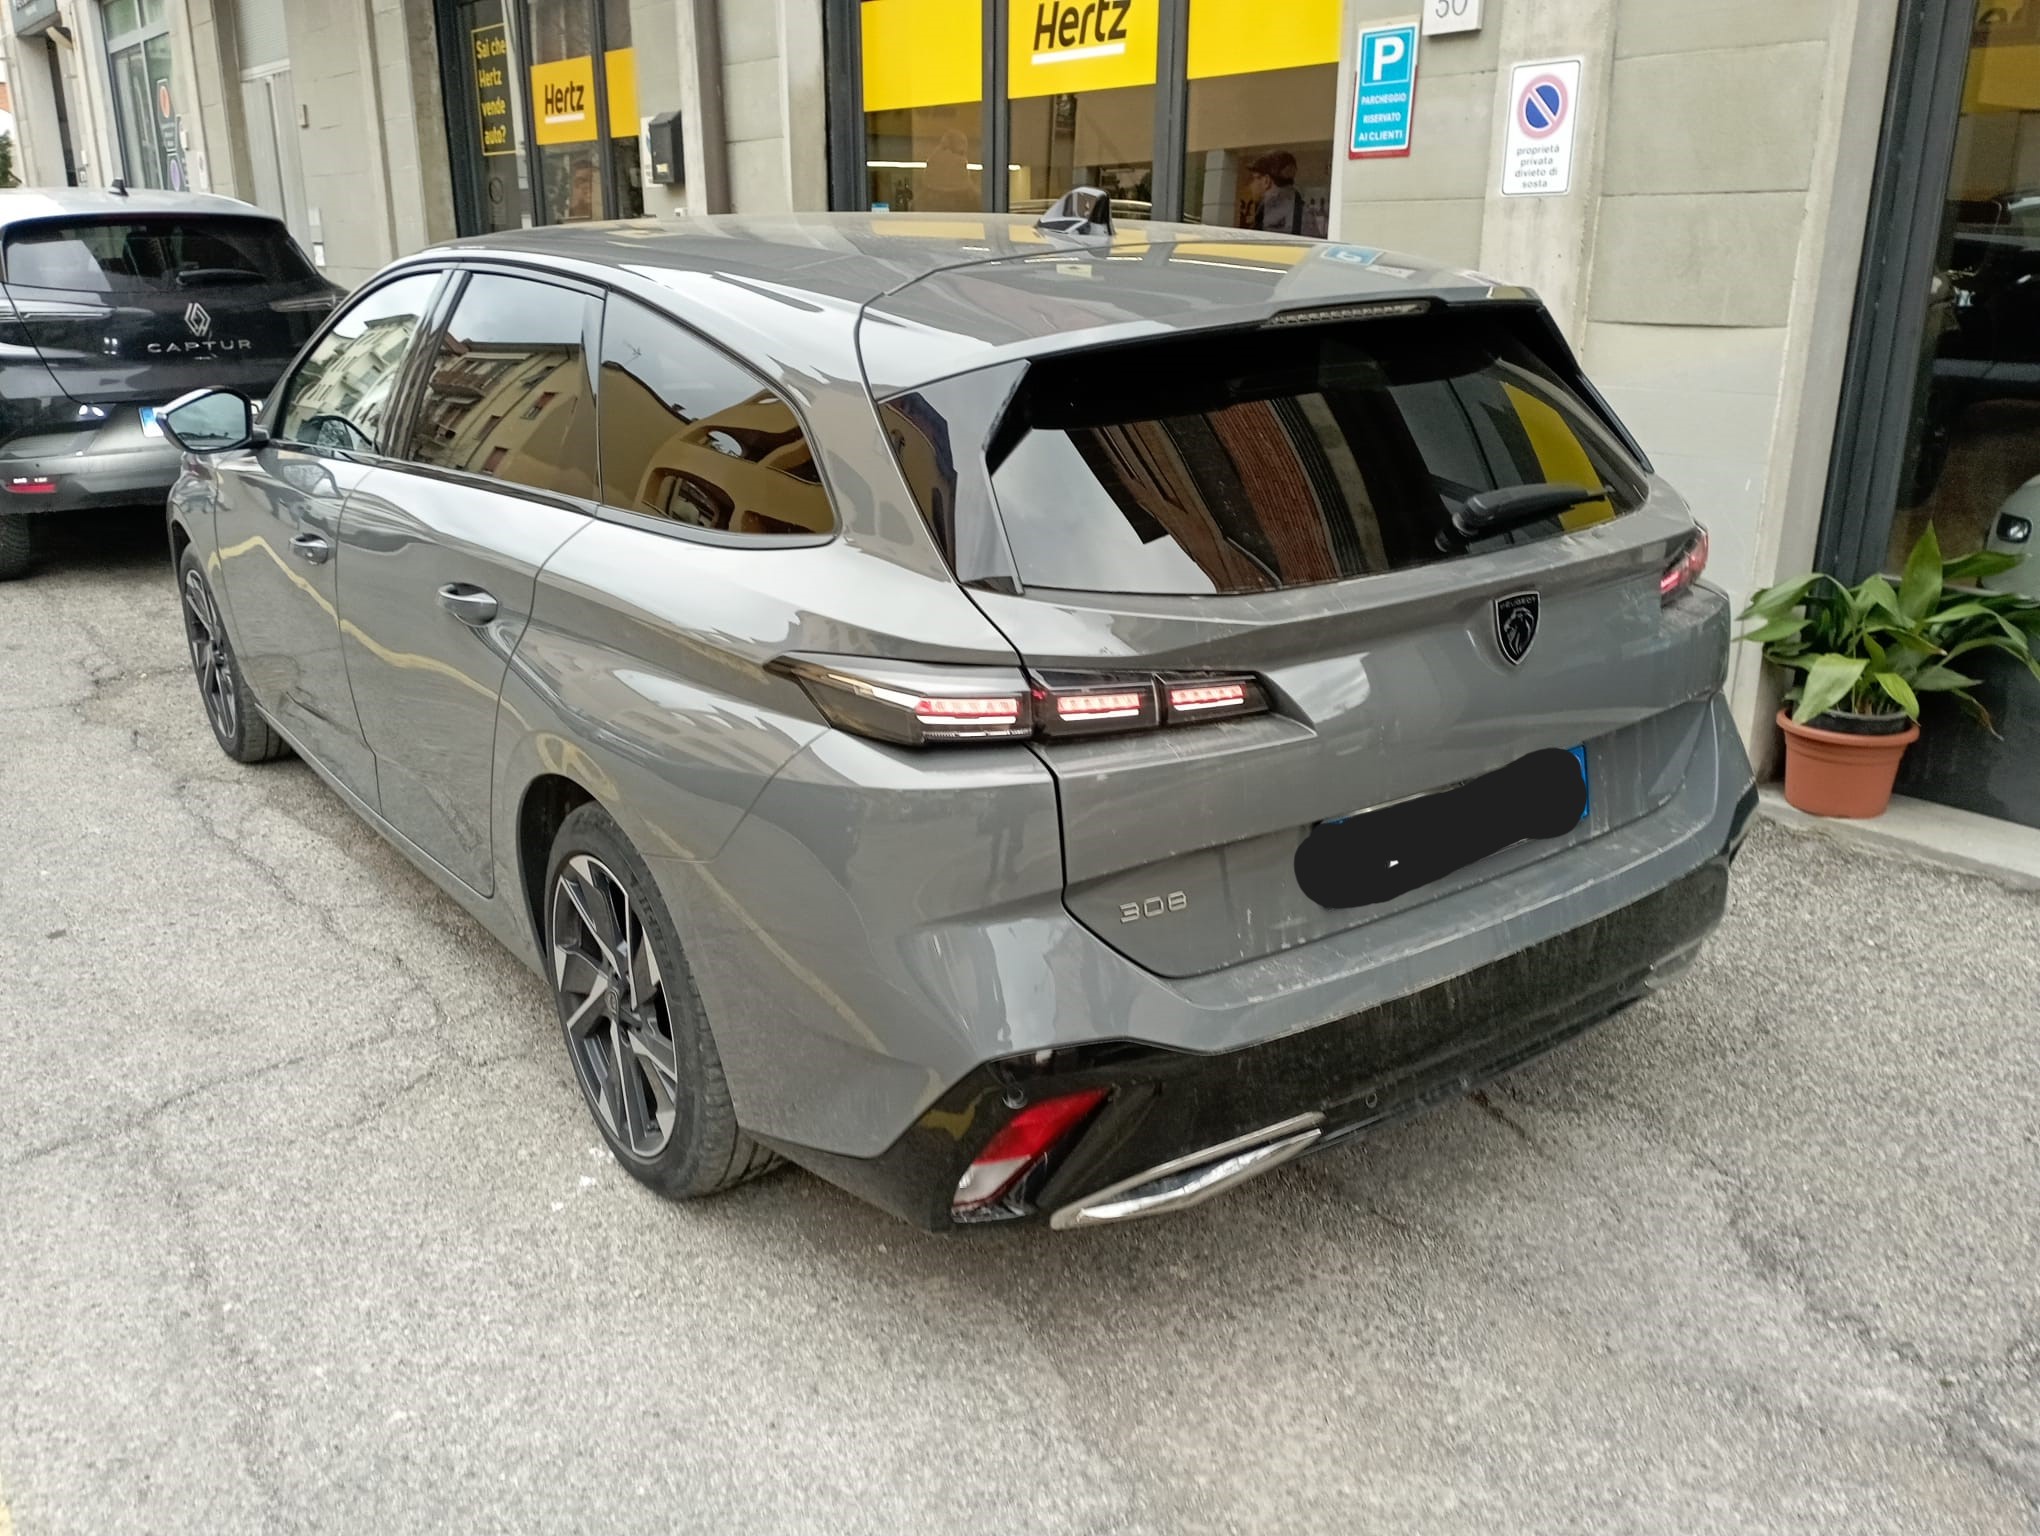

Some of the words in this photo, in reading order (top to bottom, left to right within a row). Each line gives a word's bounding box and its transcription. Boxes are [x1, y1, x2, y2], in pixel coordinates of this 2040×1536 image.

[1033, 0, 1131, 51] Hertz
[476, 39, 490, 59] Sai
[491, 37, 506, 56] che
[1372, 36, 1405, 81] P
[479, 67, 502, 88] Hertz
[482, 96, 506, 117] vende
[544, 81, 584, 115] Hertz
[1361, 92, 1407, 105] PARCHEGGIO
[1363, 112, 1401, 124] RISERVATO
[484, 125, 506, 145] auto?
[1359, 132, 1368, 141] AI
[1369, 129, 1403, 141] CLIENTI
[1520, 157, 1553, 167] privata
[1514, 168, 1546, 178] divieto
[1548, 167, 1558, 176] di
[1522, 180, 1548, 189] sosta
[147, 339, 252, 353] CAPTUR
[1119, 890, 1187, 924] 308
